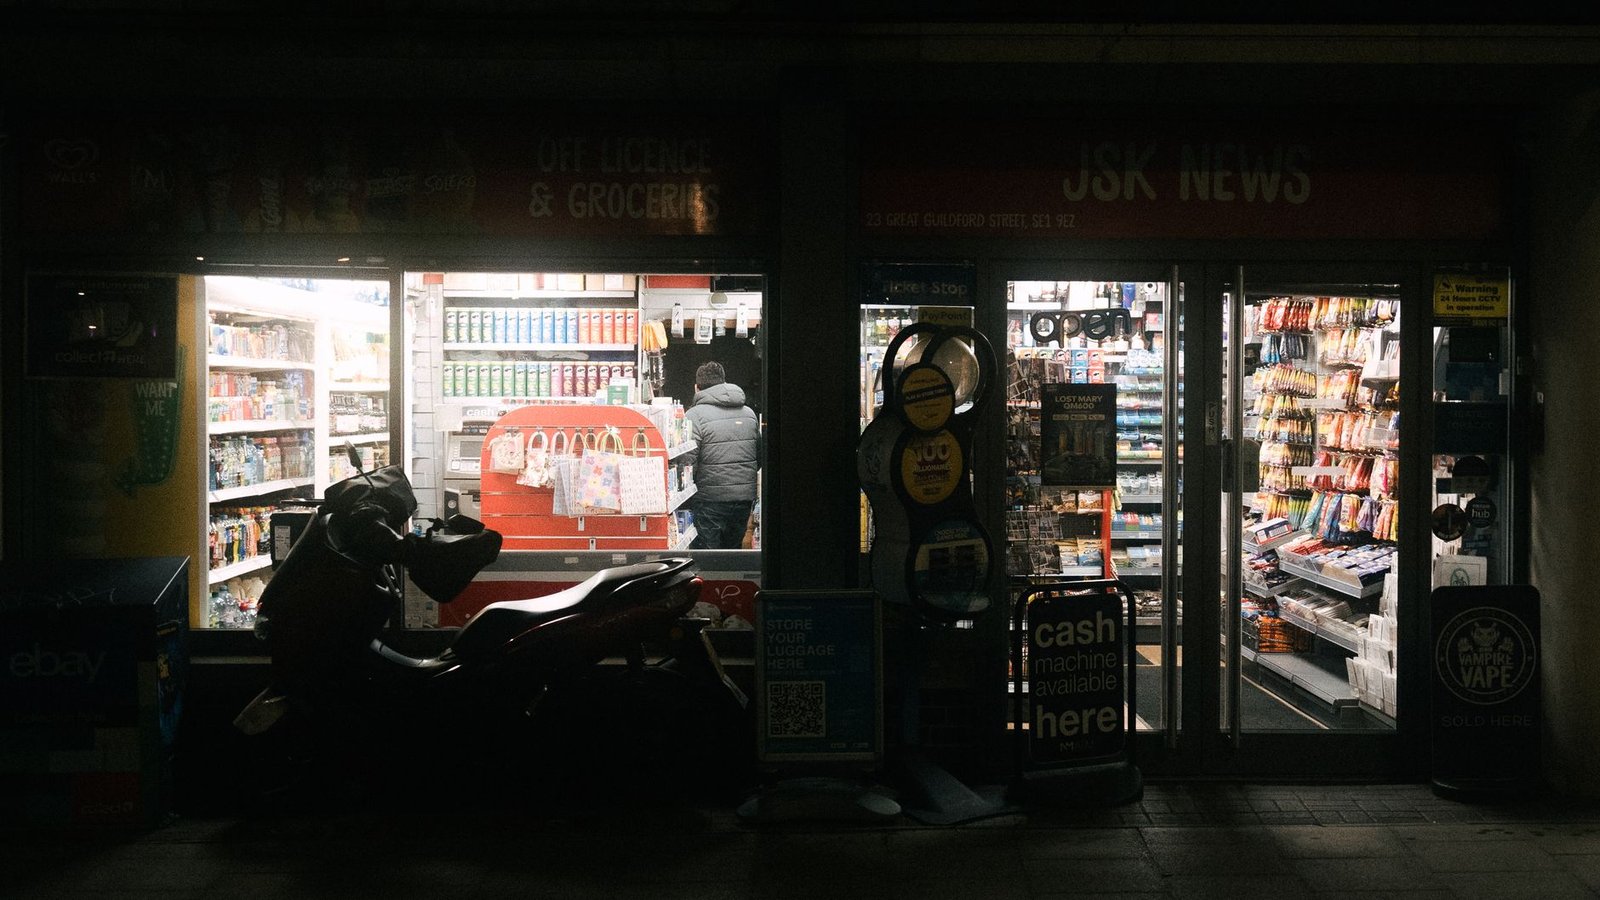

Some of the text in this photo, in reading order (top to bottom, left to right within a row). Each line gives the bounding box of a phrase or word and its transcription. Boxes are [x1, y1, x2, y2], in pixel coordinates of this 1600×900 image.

[538, 136, 713, 174] OFF LICENCE
[1062, 142, 1313, 204] JSK NEWS
[528, 182, 554, 219] &
[865, 213, 882, 228] 23
[885, 213, 920, 228] GREAT
[923, 213, 985, 228] GUILDFORD
[1032, 213, 1051, 228] SE1
[1055, 213, 1076, 229] 9EZ
[931, 281, 968, 297] Stop
[1455, 284, 1499, 295] Warning
[921, 310, 969, 322] PayPoint
[1456, 304, 1495, 312] operation
[1030, 309, 1132, 349] open
[135, 382, 177, 398] WANT
[1055, 395, 1103, 403] LOST MARY
[145, 400, 167, 417] ME
[1471, 508, 1490, 518] hub
[767, 619, 814, 631] STORE
[1034, 610, 1116, 648] cash
[767, 632, 807, 643] YOUR
[767, 645, 836, 656] LUGGAGE
[9, 642, 108, 683] ebay
[767, 658, 806, 670] HERE
[1035, 650, 1118, 675] machine
[1458, 652, 1514, 666] VAMPIRE
[1035, 670, 1118, 697] available
[1460, 665, 1514, 689] VAPE
[1035, 704, 1118, 739] here
[1440, 714, 1536, 727] SOLD HERE
